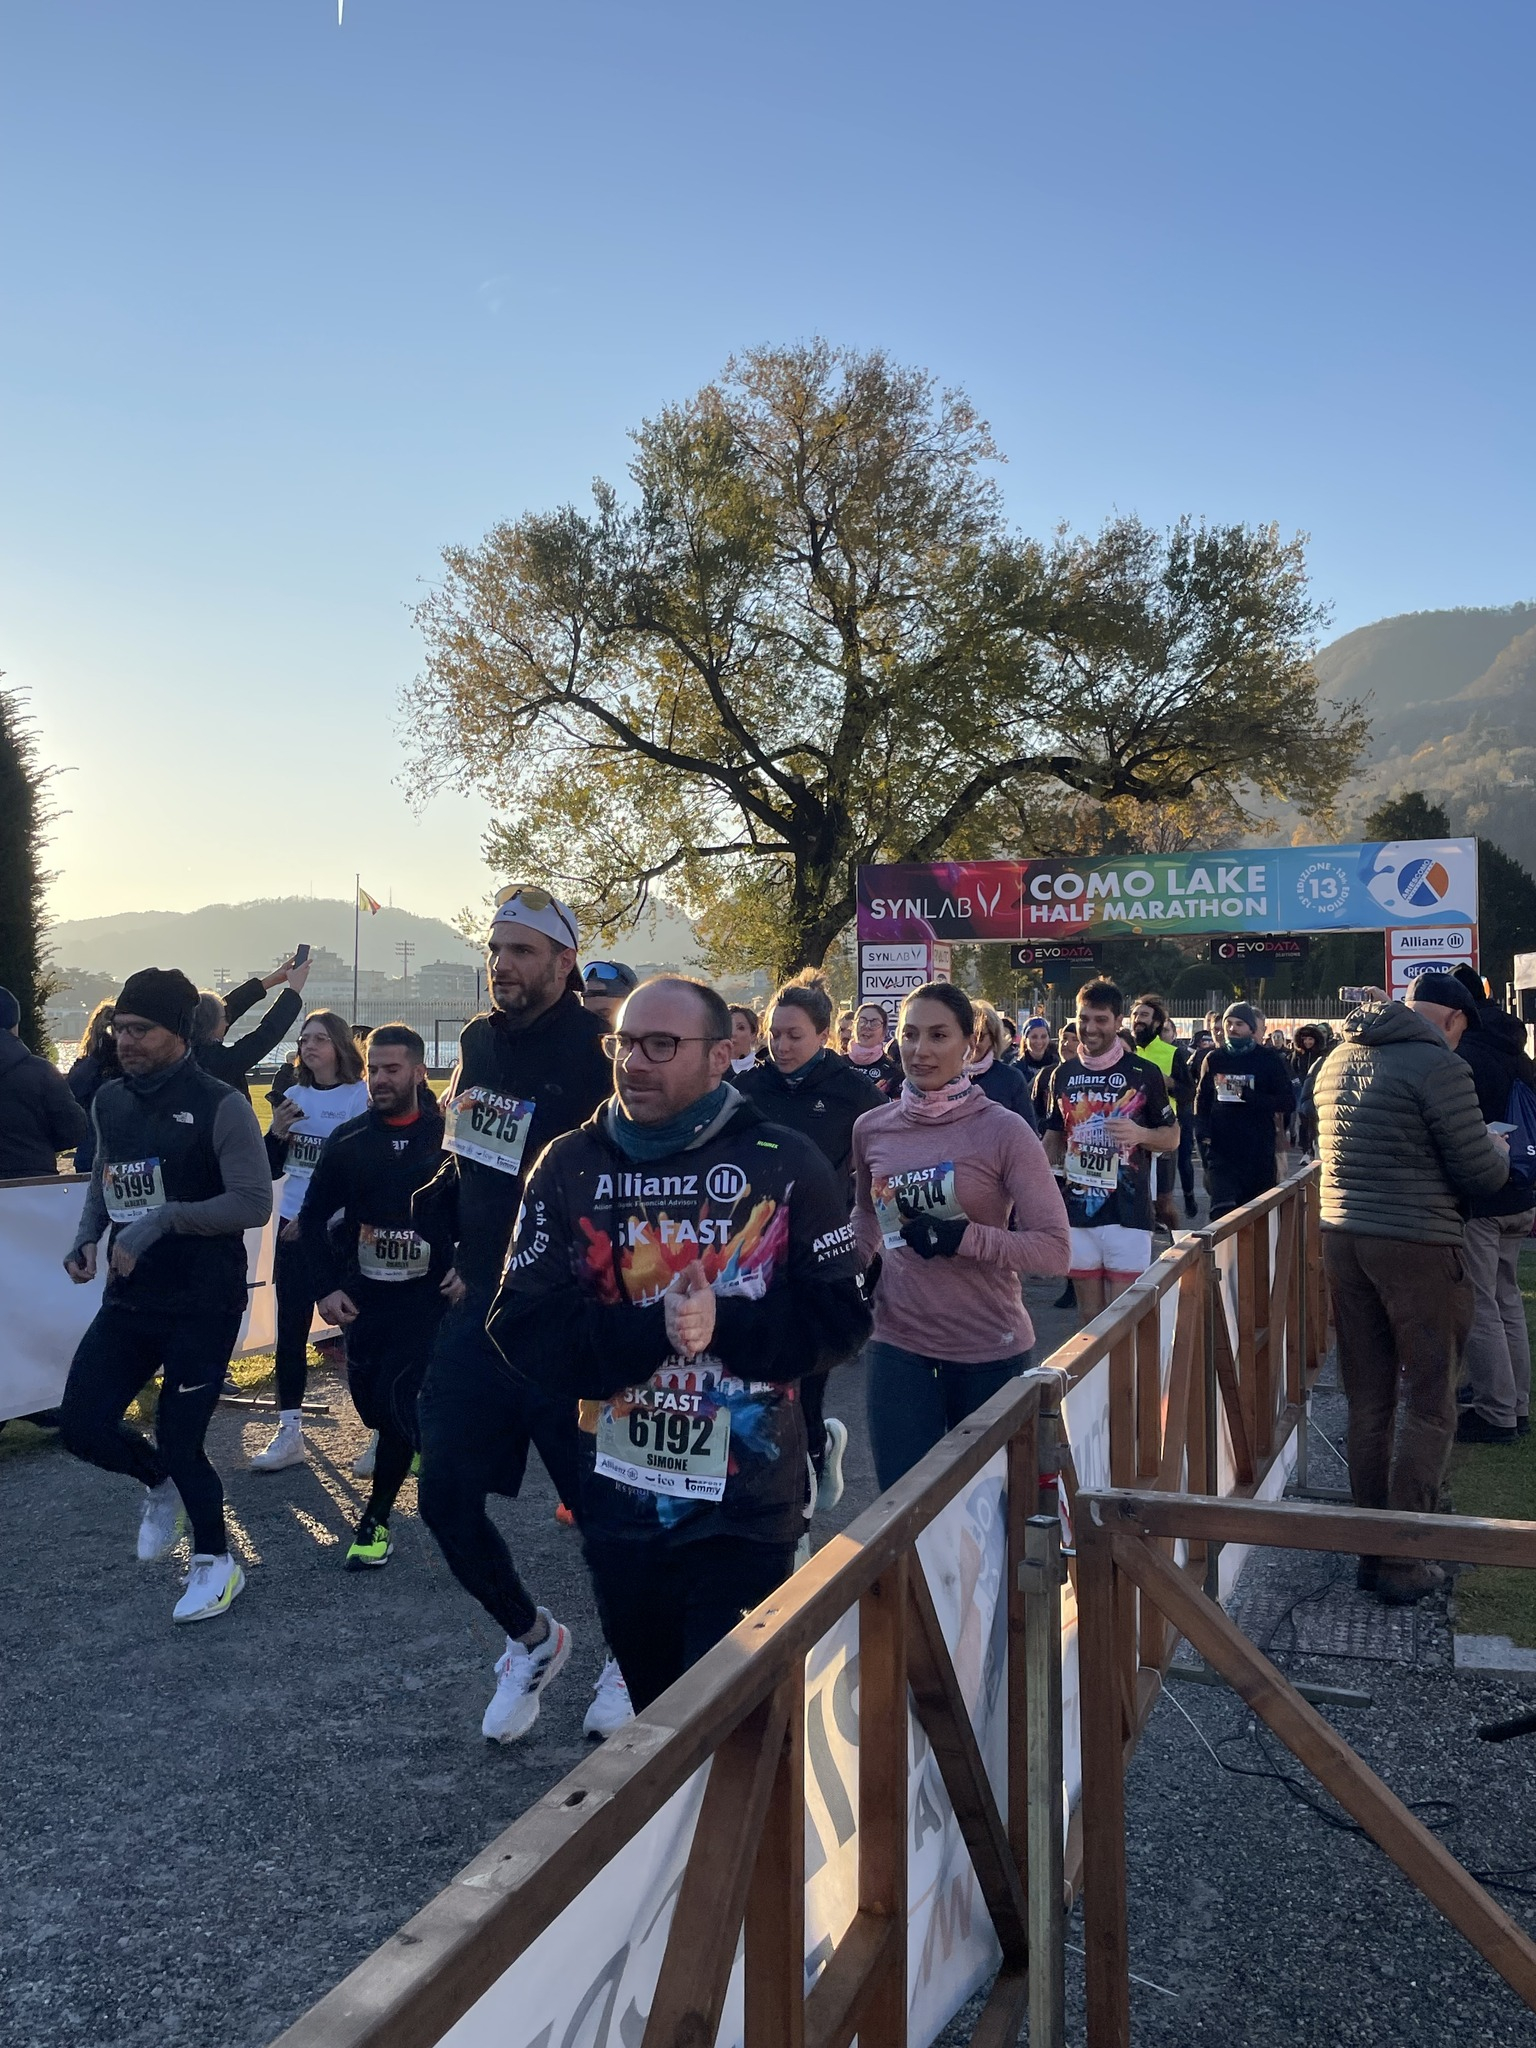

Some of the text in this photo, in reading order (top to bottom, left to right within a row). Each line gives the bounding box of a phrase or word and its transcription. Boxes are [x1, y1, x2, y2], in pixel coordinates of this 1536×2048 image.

[1029, 865, 1266, 900] COMO LAKE
[1297, 862, 1331, 893] EDIZIONE
[1309, 877, 1338, 899] 13
[1402, 860, 1430, 899] ARIESCOMO
[870, 898, 972, 920] SYNLAB
[1030, 897, 1267, 923] HALF MARATHON
[1318, 886, 1350, 913] EDITION
[1034, 947, 1094, 958] EVODATA
[1236, 941, 1300, 952] EVODATA
[1400, 937, 1444, 947] Allianz
[868, 952, 910, 962] SYNLAB
[866, 976, 923, 989] RIVAUTO
[1067, 1074, 1106, 1086] Allianz
[469, 1089, 519, 1112] 5K FAST
[1069, 1092, 1118, 1103] 5K FAST
[471, 1101, 519, 1143] 6215
[304, 1135, 322, 1146] FAST
[1089, 1145, 1108, 1156] FAST
[122, 1162, 145, 1174] FAST
[1080, 1153, 1112, 1172] 6201
[112, 1173, 156, 1200] 6199
[594, 1172, 698, 1200] Allianz
[888, 1167, 936, 1189] 5K FAST
[373, 1229, 415, 1240] 5K FAST
[660, 1219, 733, 1244] FAST
[375, 1239, 421, 1261] 6016
[506, 1230, 550, 1271] EDITIO
[818, 1239, 857, 1262] ATHLET
[623, 1387, 702, 1412] 5K FAST
[629, 1406, 714, 1456] 6192
[601, 1459, 675, 1486] Allianz ico
[646, 1453, 688, 1472] SIMONE
[685, 1477, 721, 1495] tommy
